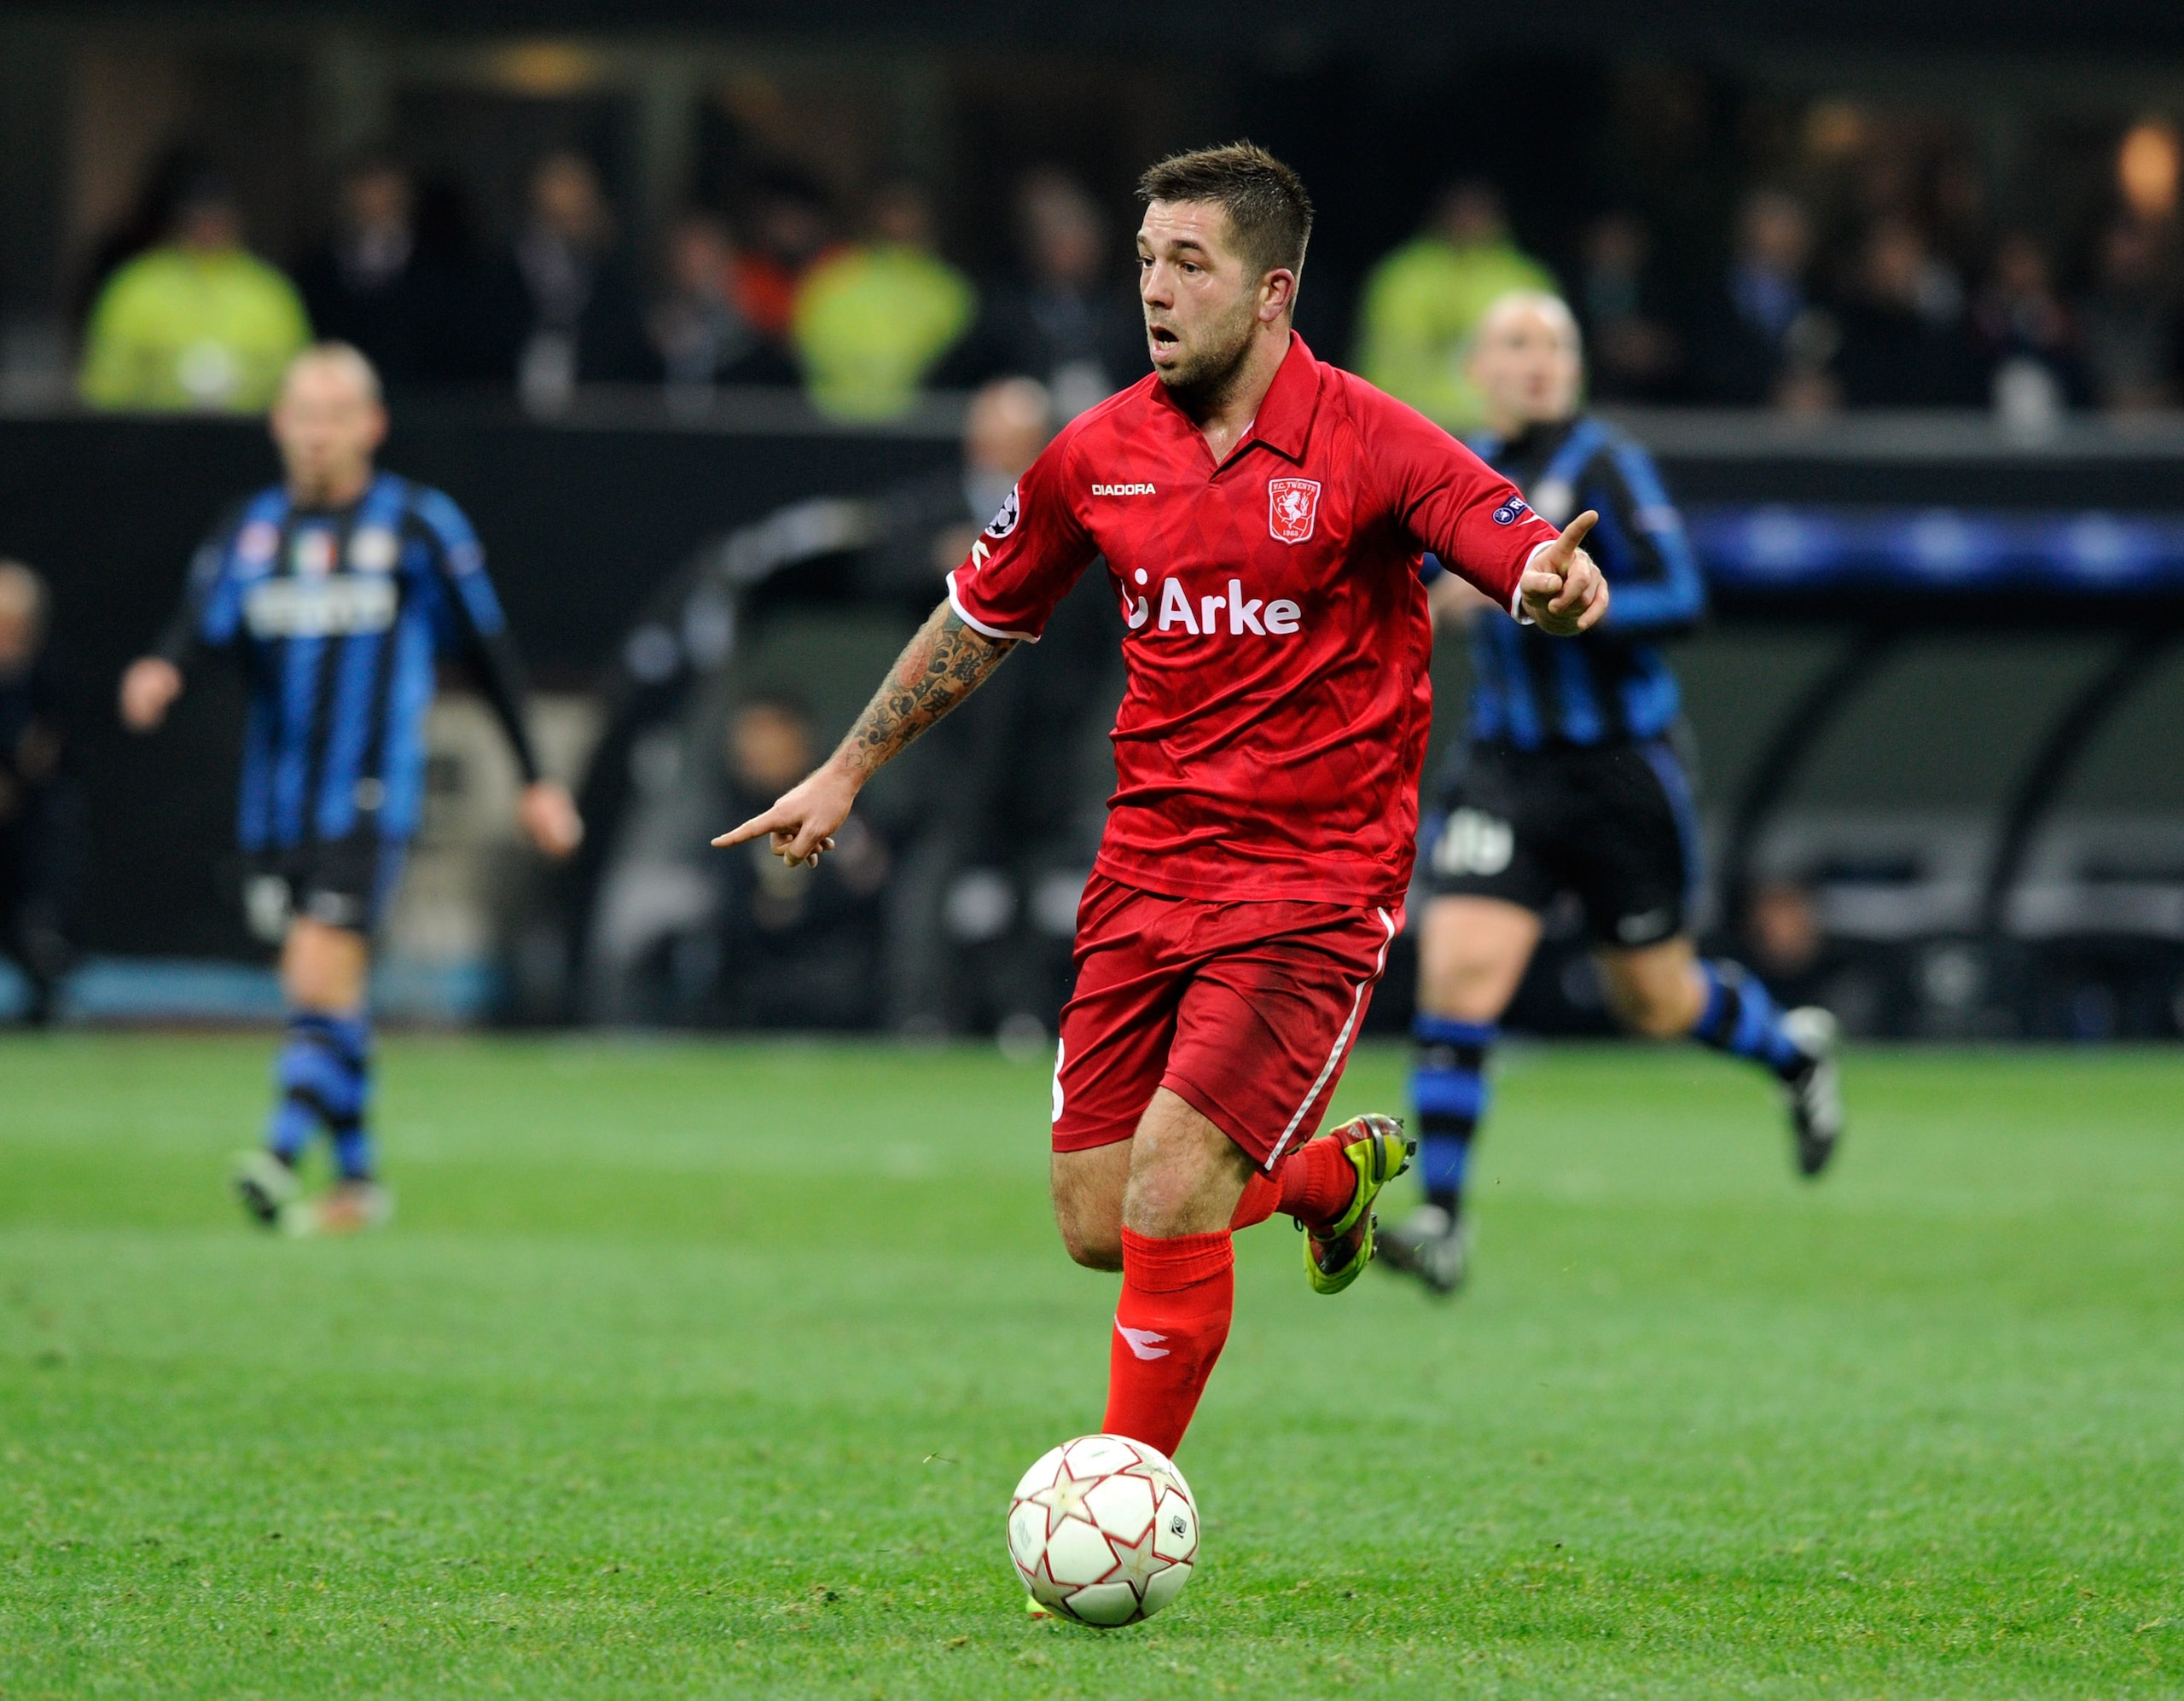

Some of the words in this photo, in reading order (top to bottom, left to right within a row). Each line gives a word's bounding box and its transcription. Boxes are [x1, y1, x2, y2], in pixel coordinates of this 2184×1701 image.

[1092, 483, 1156, 496] DIADORA
[1287, 482, 1316, 492] TWENTE
[1159, 577, 1301, 636] Arke
